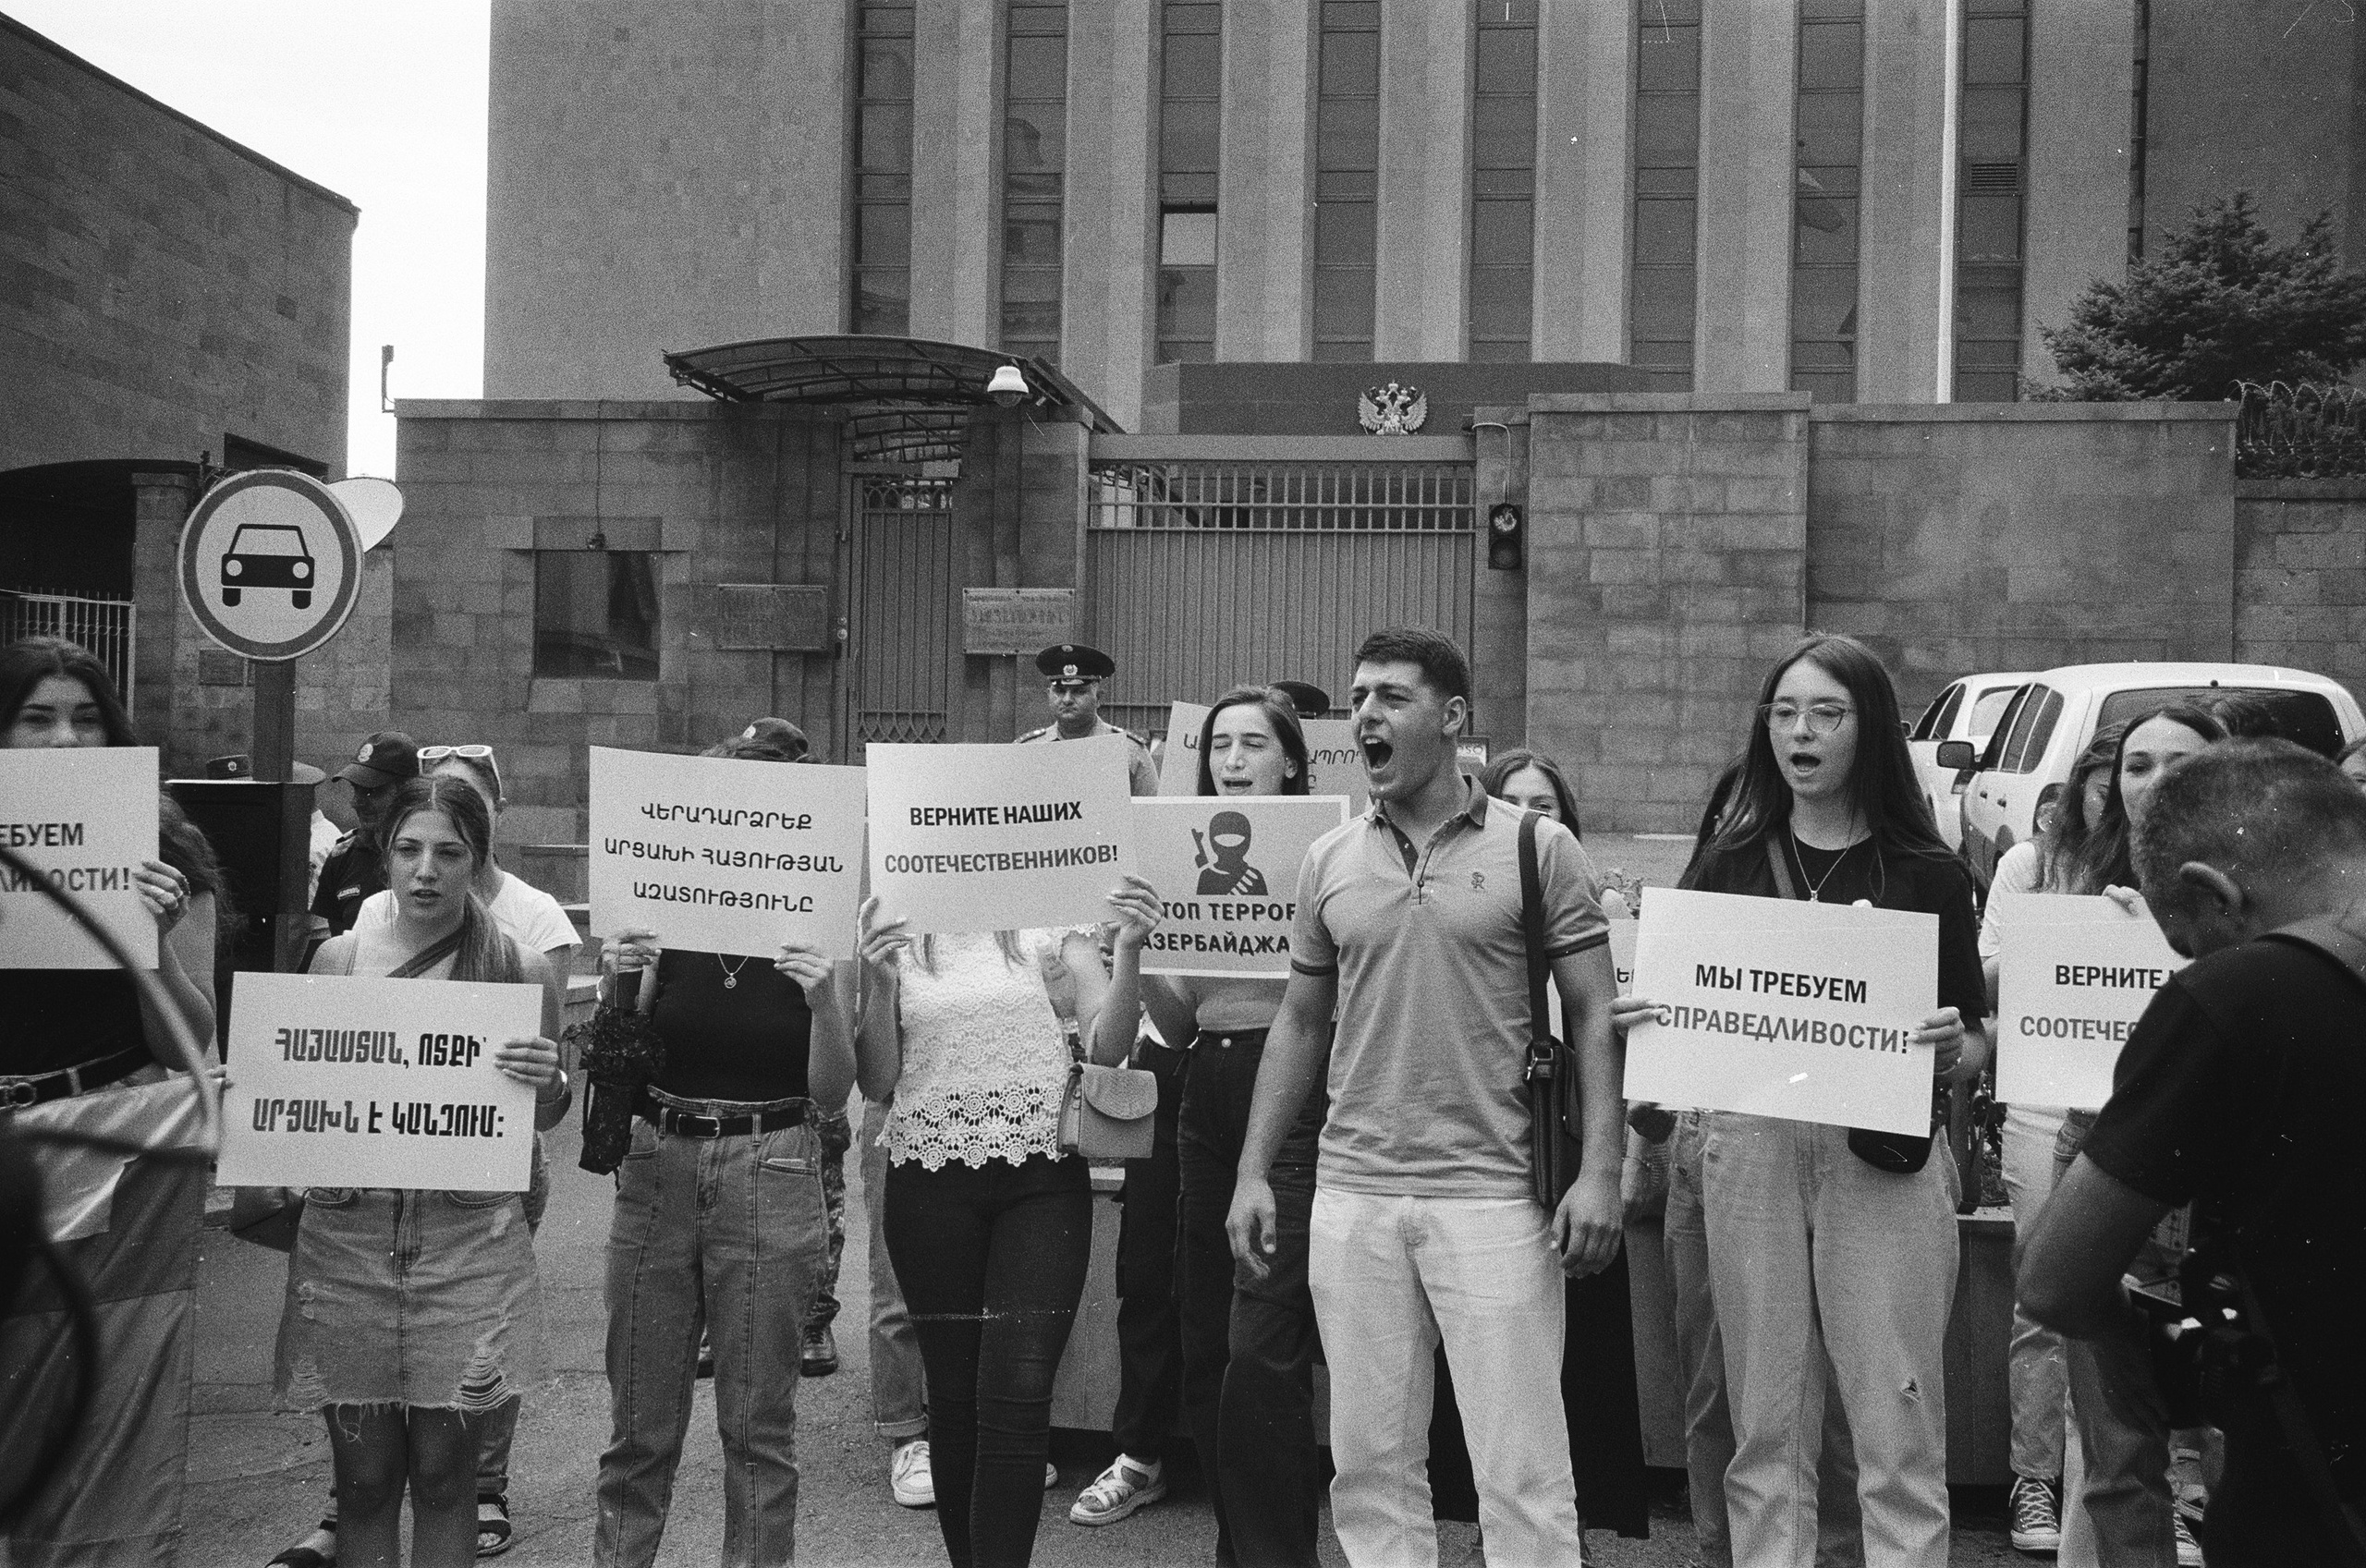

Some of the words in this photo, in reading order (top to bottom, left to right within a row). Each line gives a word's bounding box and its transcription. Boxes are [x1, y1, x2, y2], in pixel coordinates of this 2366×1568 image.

[641, 802, 812, 831] ՎԵՐԱԴԱՐՁՐԵՔ
[909, 807, 1000, 826] ВЕРНИТЕ
[1003, 800, 1083, 825] НАШИХ
[604, 837, 695, 863] ԱՐՑԱԽԻ
[701, 847, 844, 873] ՀԱՅՈՒԹՅԱՆ
[884, 844, 1118, 874] СООТЕЧЕСТВЕННИКОВ!
[633, 881, 813, 913] ԱԶԱՏՈՒԹՅՈՒՆԸ
[1161, 901, 1201, 921] ТОП
[1140, 930, 1291, 957] АЗЕРБАЙДЖА
[1694, 964, 1743, 991] МЫ
[1749, 969, 1867, 1004] ТРЕБУЕМ
[2055, 965, 2164, 990] ВЕРНИТЕ
[1655, 1003, 1909, 1054] СПРАВЕДЛИВОСТИ!
[274, 1027, 409, 1069] ՀԱՅԱՍՏԱՆ,
[252, 1098, 360, 1134] ԱՐՑԱԽՆ
[367, 1100, 384, 1134] Է
